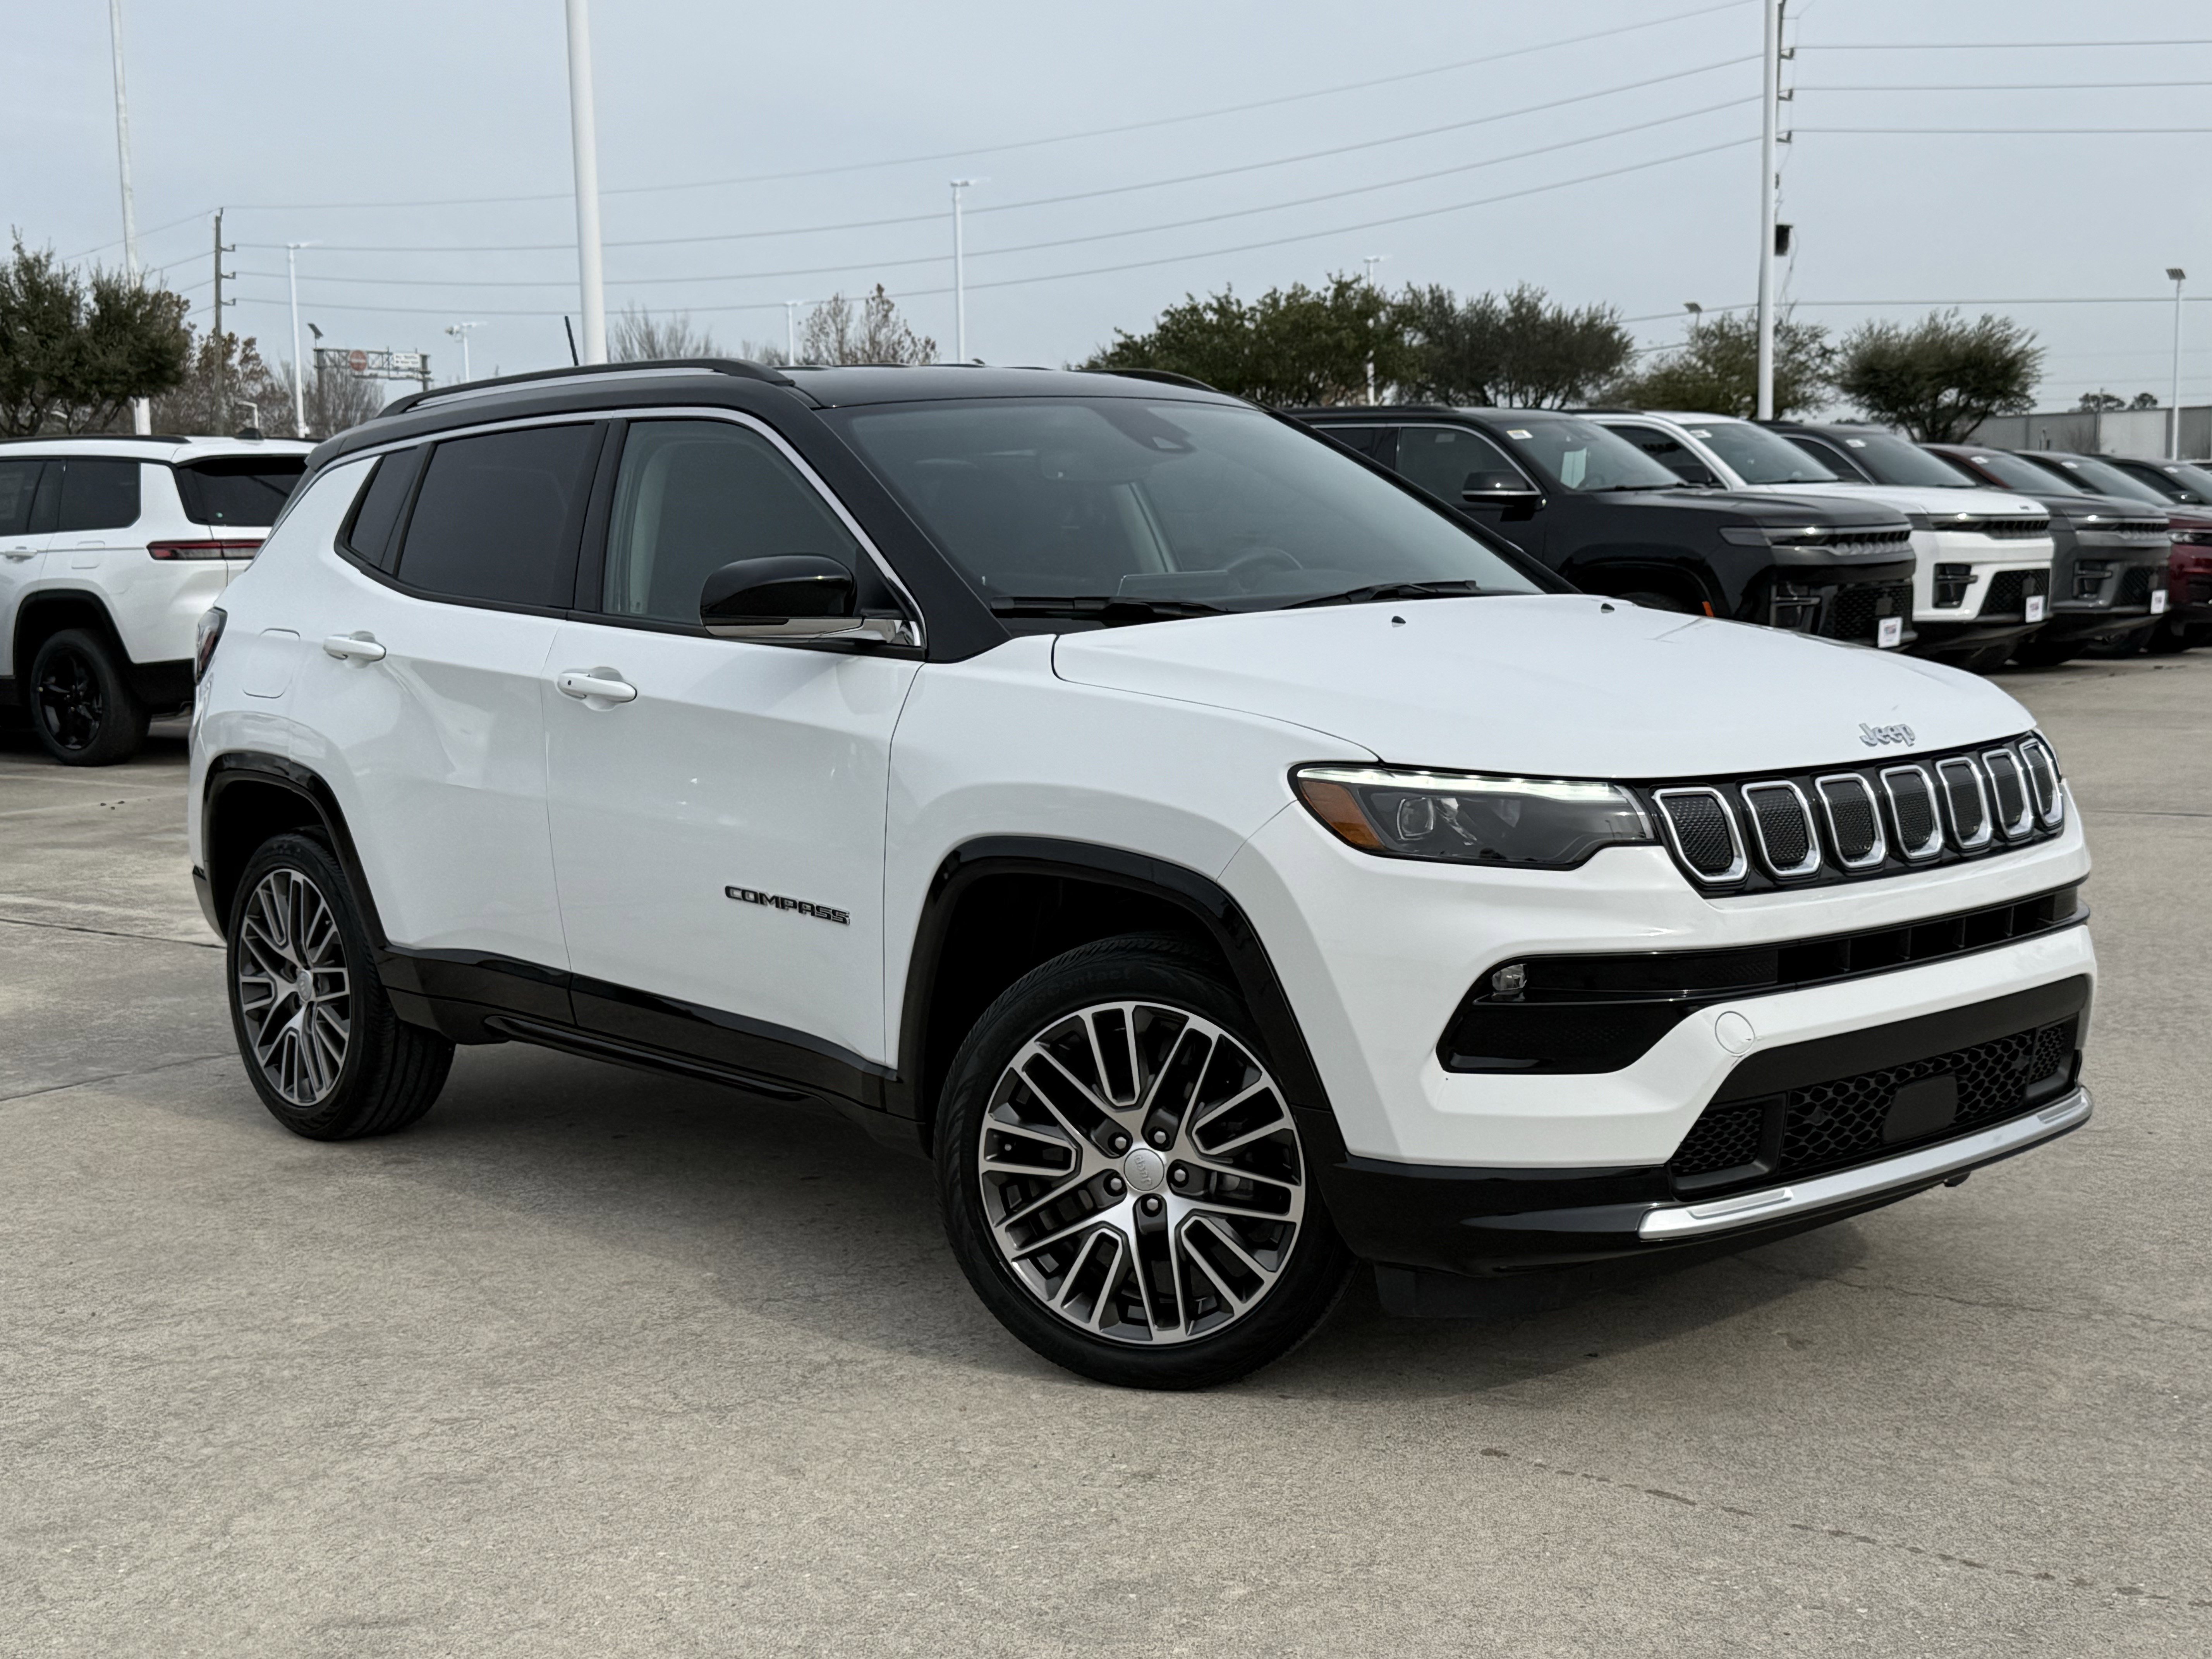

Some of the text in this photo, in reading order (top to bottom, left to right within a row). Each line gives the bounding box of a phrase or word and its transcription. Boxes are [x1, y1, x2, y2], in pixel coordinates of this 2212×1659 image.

[1859, 723, 1915, 747] Jeep
[725, 886, 850, 925] COMPASS
[1134, 1154, 1152, 1187] Jeep
